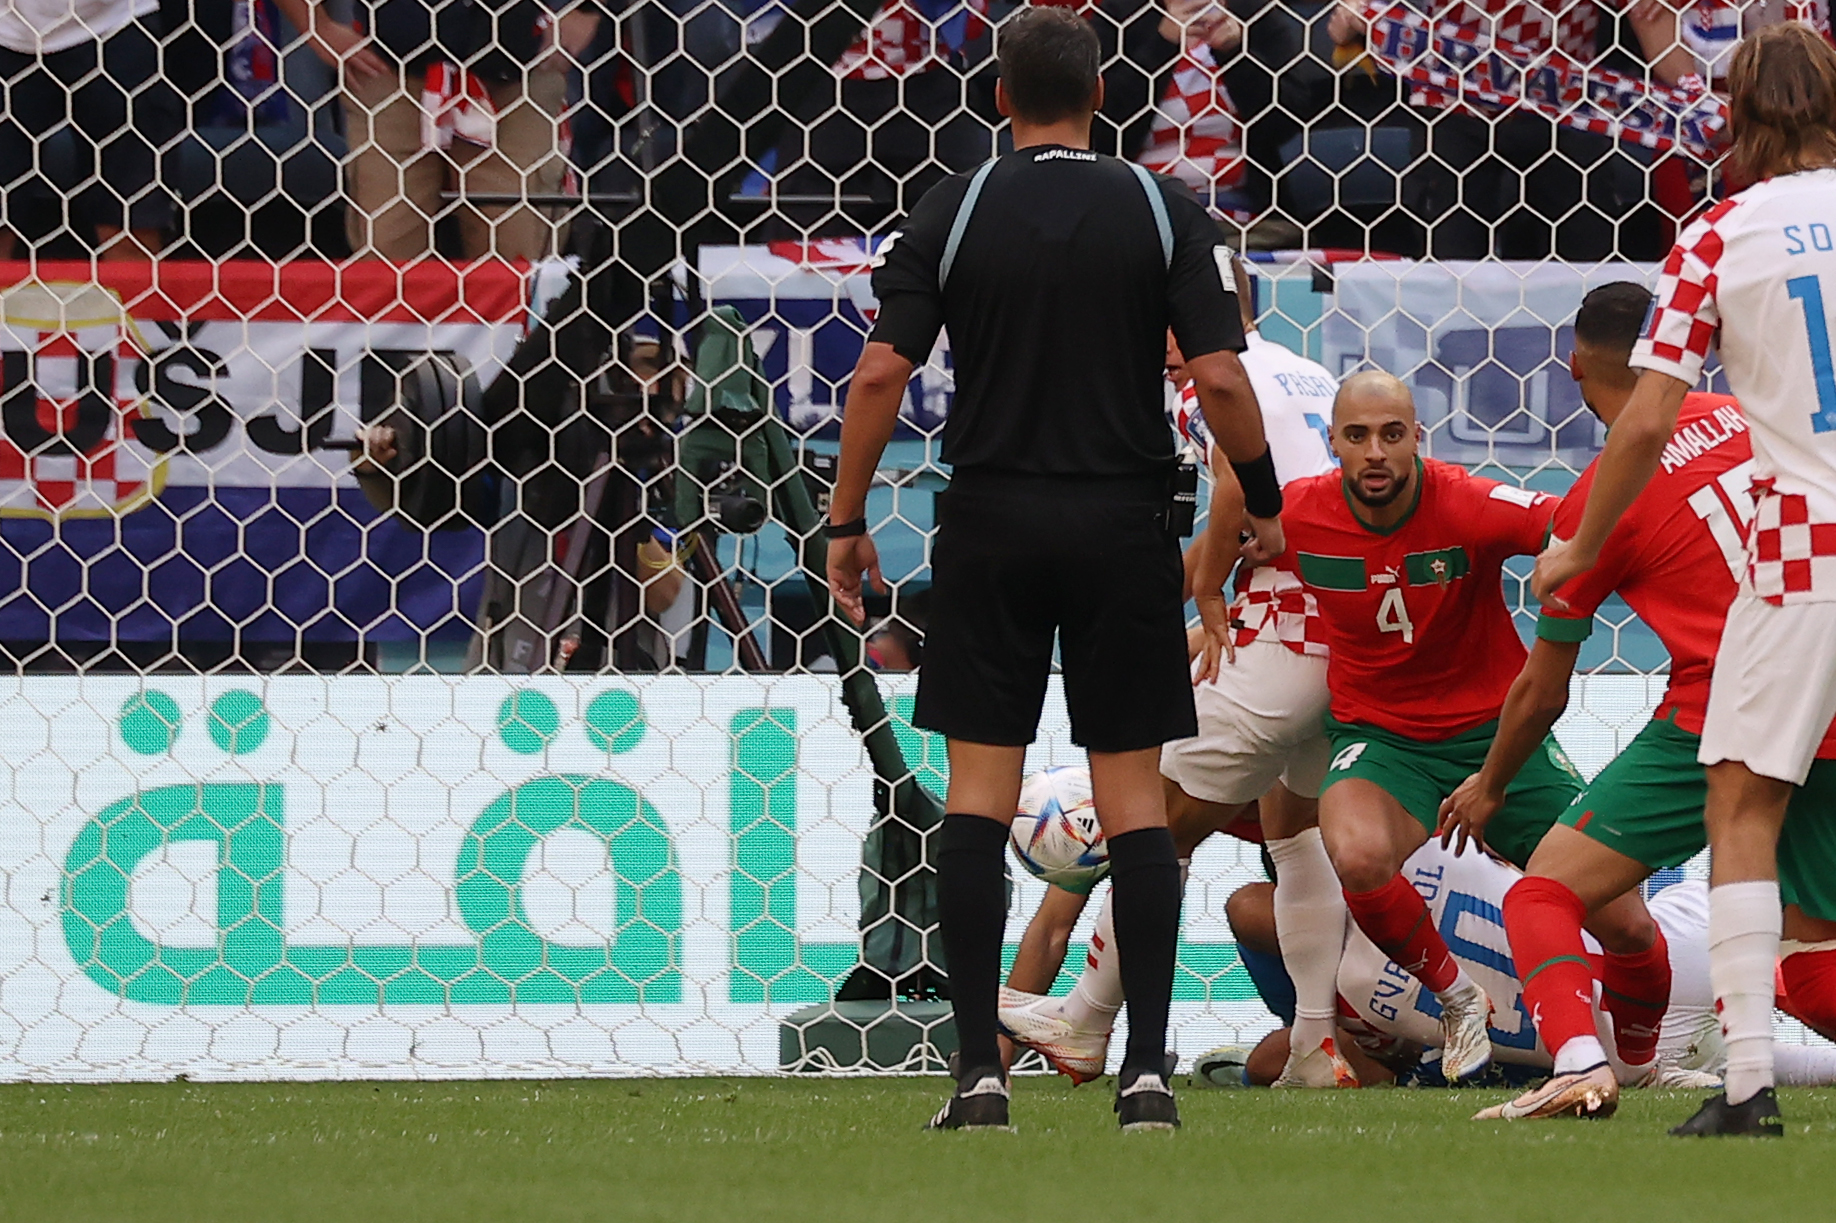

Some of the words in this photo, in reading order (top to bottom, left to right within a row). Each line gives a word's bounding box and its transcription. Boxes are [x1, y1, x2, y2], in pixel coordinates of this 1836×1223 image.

[1034, 149, 1098, 162] RAPALLINI
[1376, 587, 1413, 644] 4
[1329, 742, 1368, 772] 4
